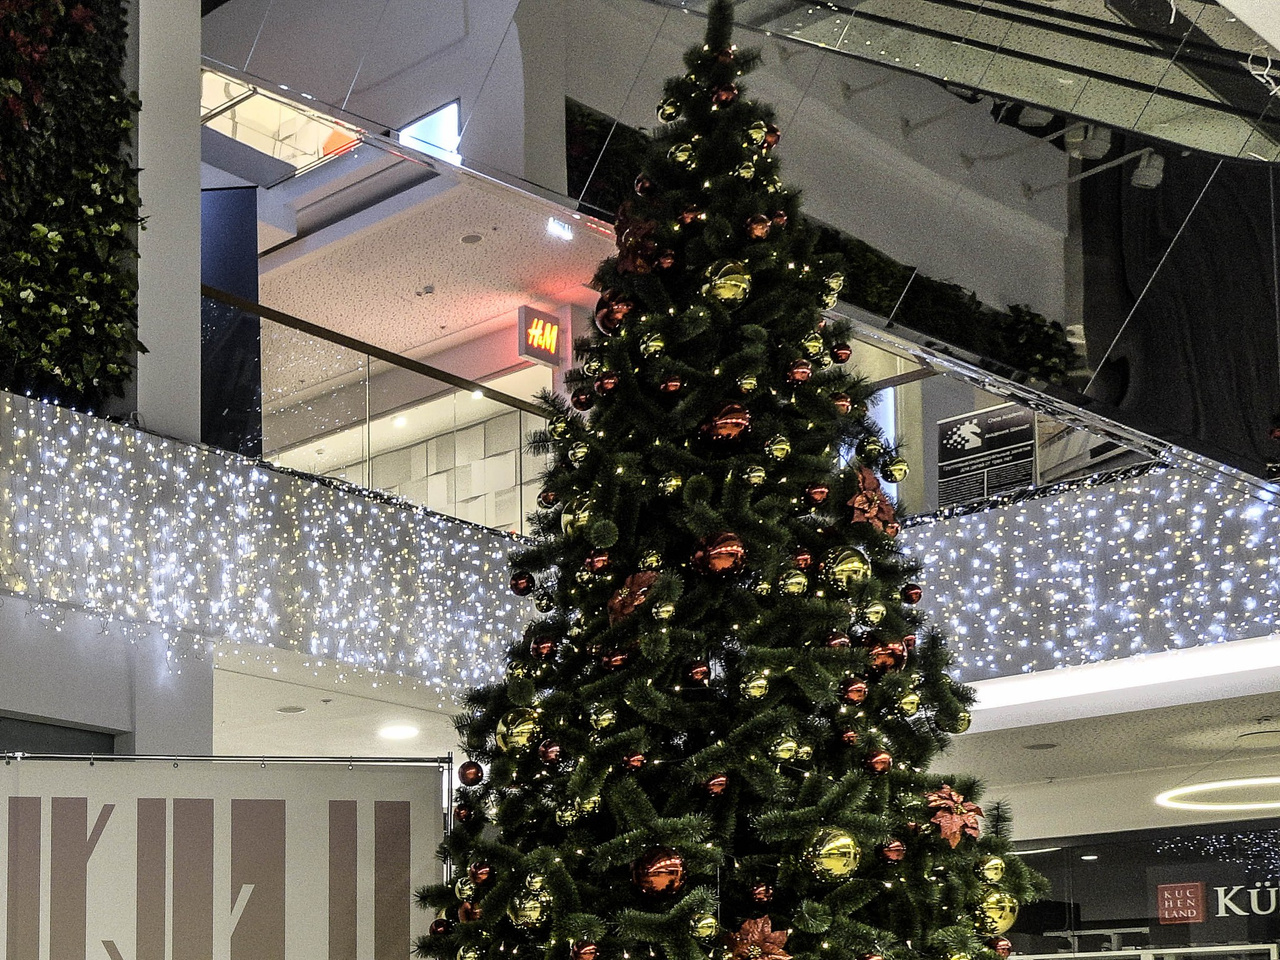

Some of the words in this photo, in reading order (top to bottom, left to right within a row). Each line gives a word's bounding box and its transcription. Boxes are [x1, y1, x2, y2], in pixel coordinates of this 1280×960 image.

[527, 317, 558, 354] H&M
[1165, 909, 1197, 919] LAND
[1213, 881, 1279, 917] KÜ
